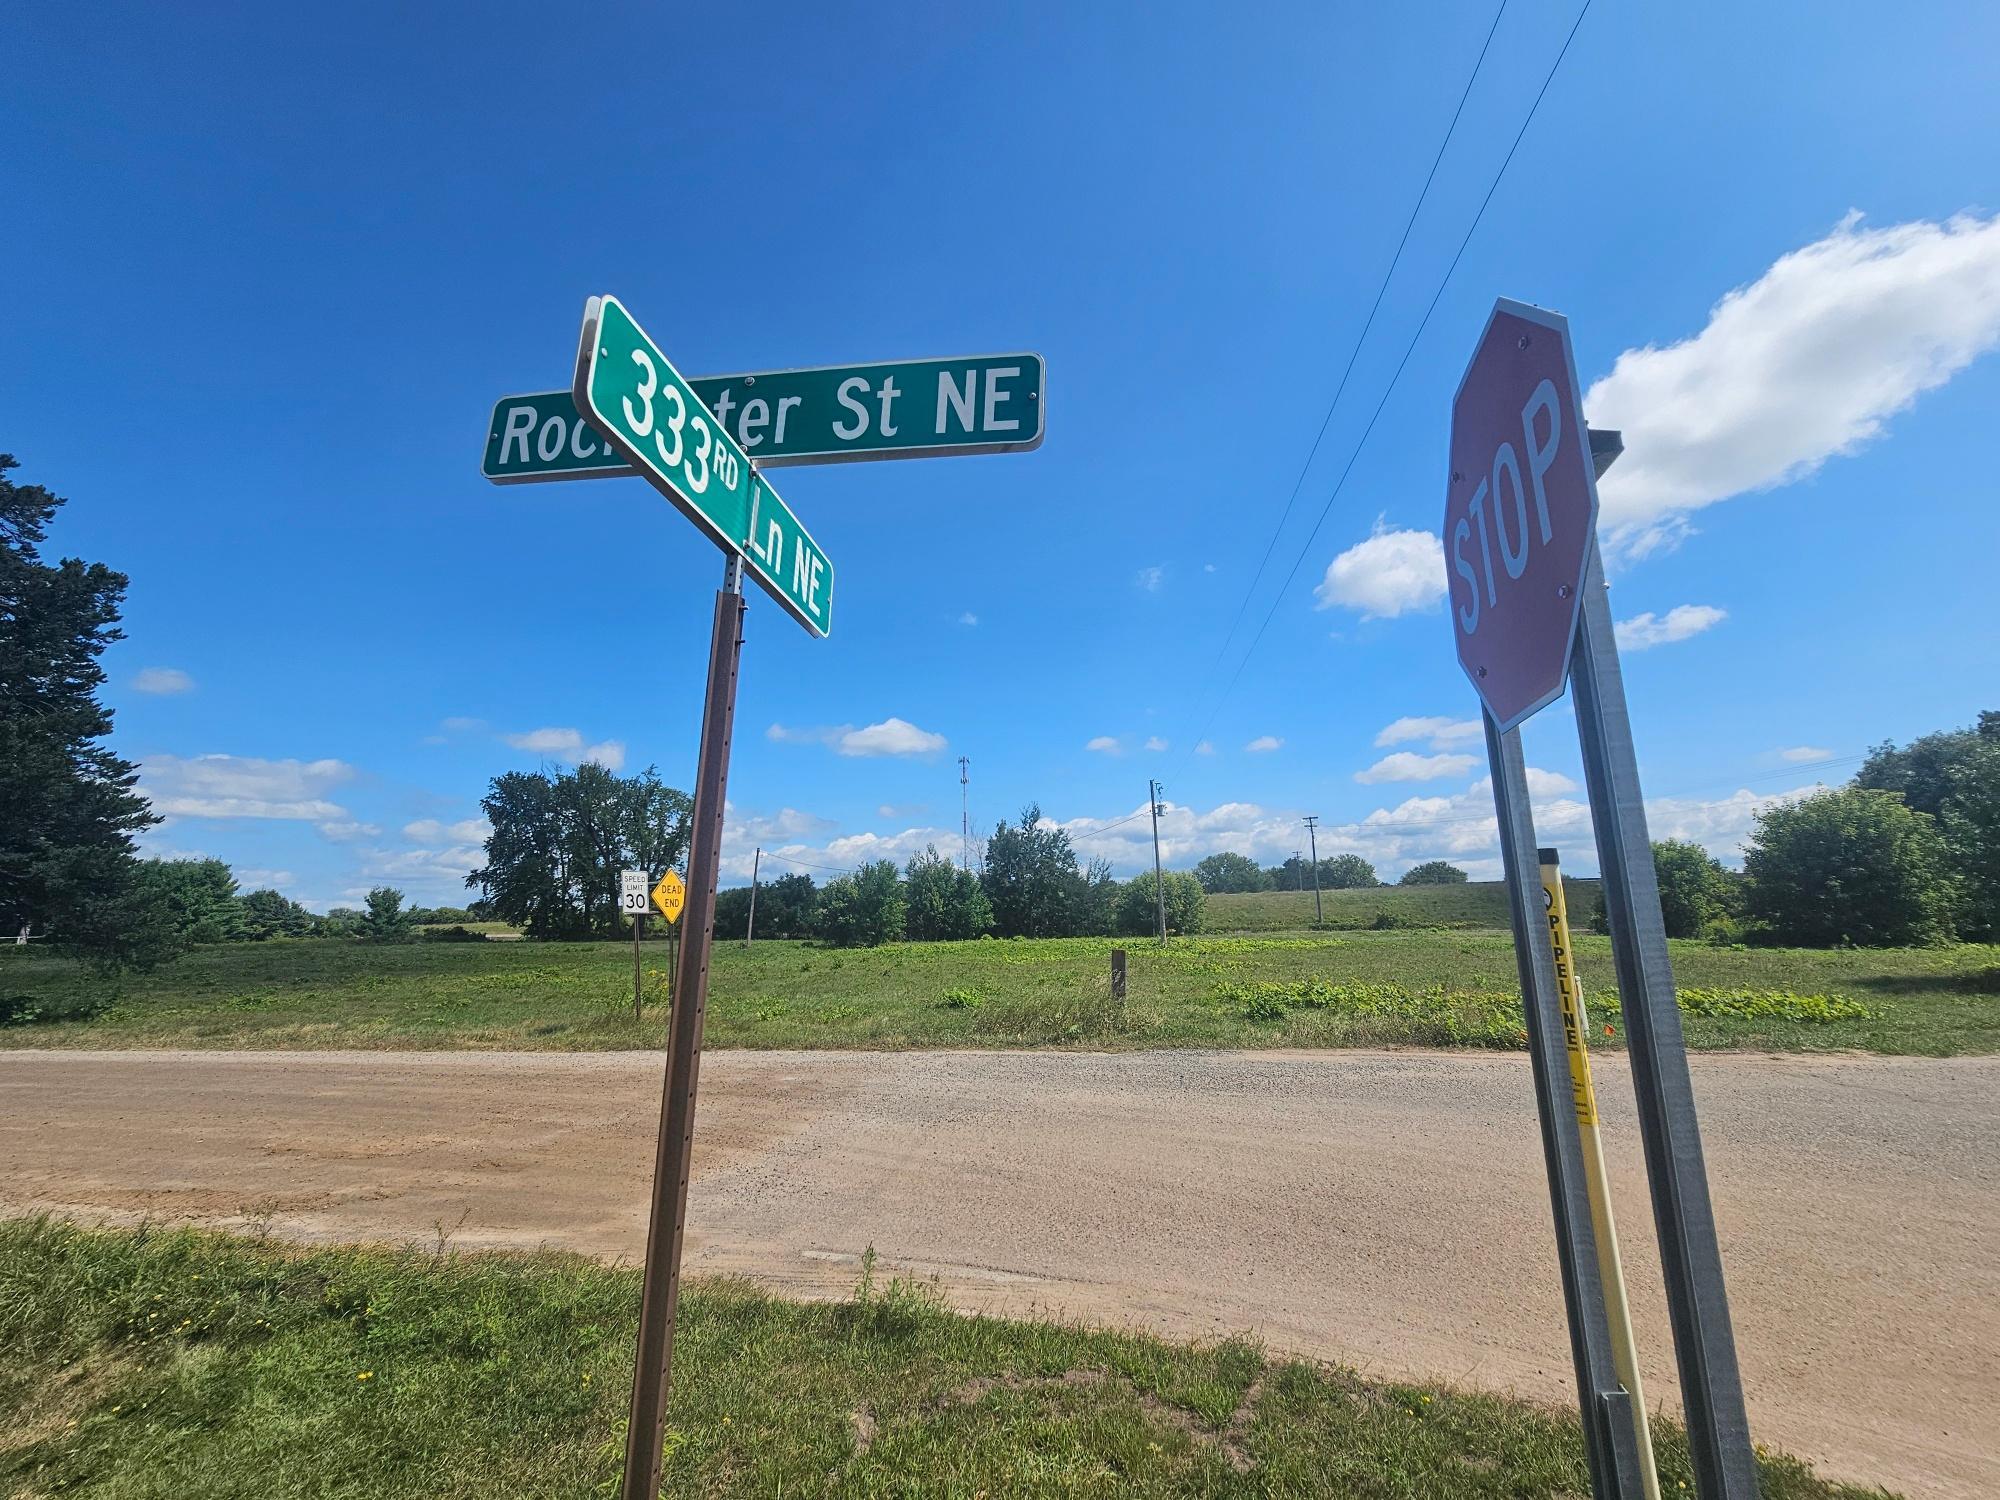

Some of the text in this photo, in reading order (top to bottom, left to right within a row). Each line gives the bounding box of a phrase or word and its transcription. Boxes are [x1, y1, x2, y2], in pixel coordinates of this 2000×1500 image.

[498, 366, 1021, 465] Rocter St NE
[750, 485, 782, 576] Ln
[793, 535, 825, 618] NE
[1453, 378, 1561, 635] STOP
[626, 893, 645, 908] 30
[661, 885, 681, 893] DEAD
[665, 899, 679, 907] END
[1549, 914, 1577, 1045] PIPELINE
